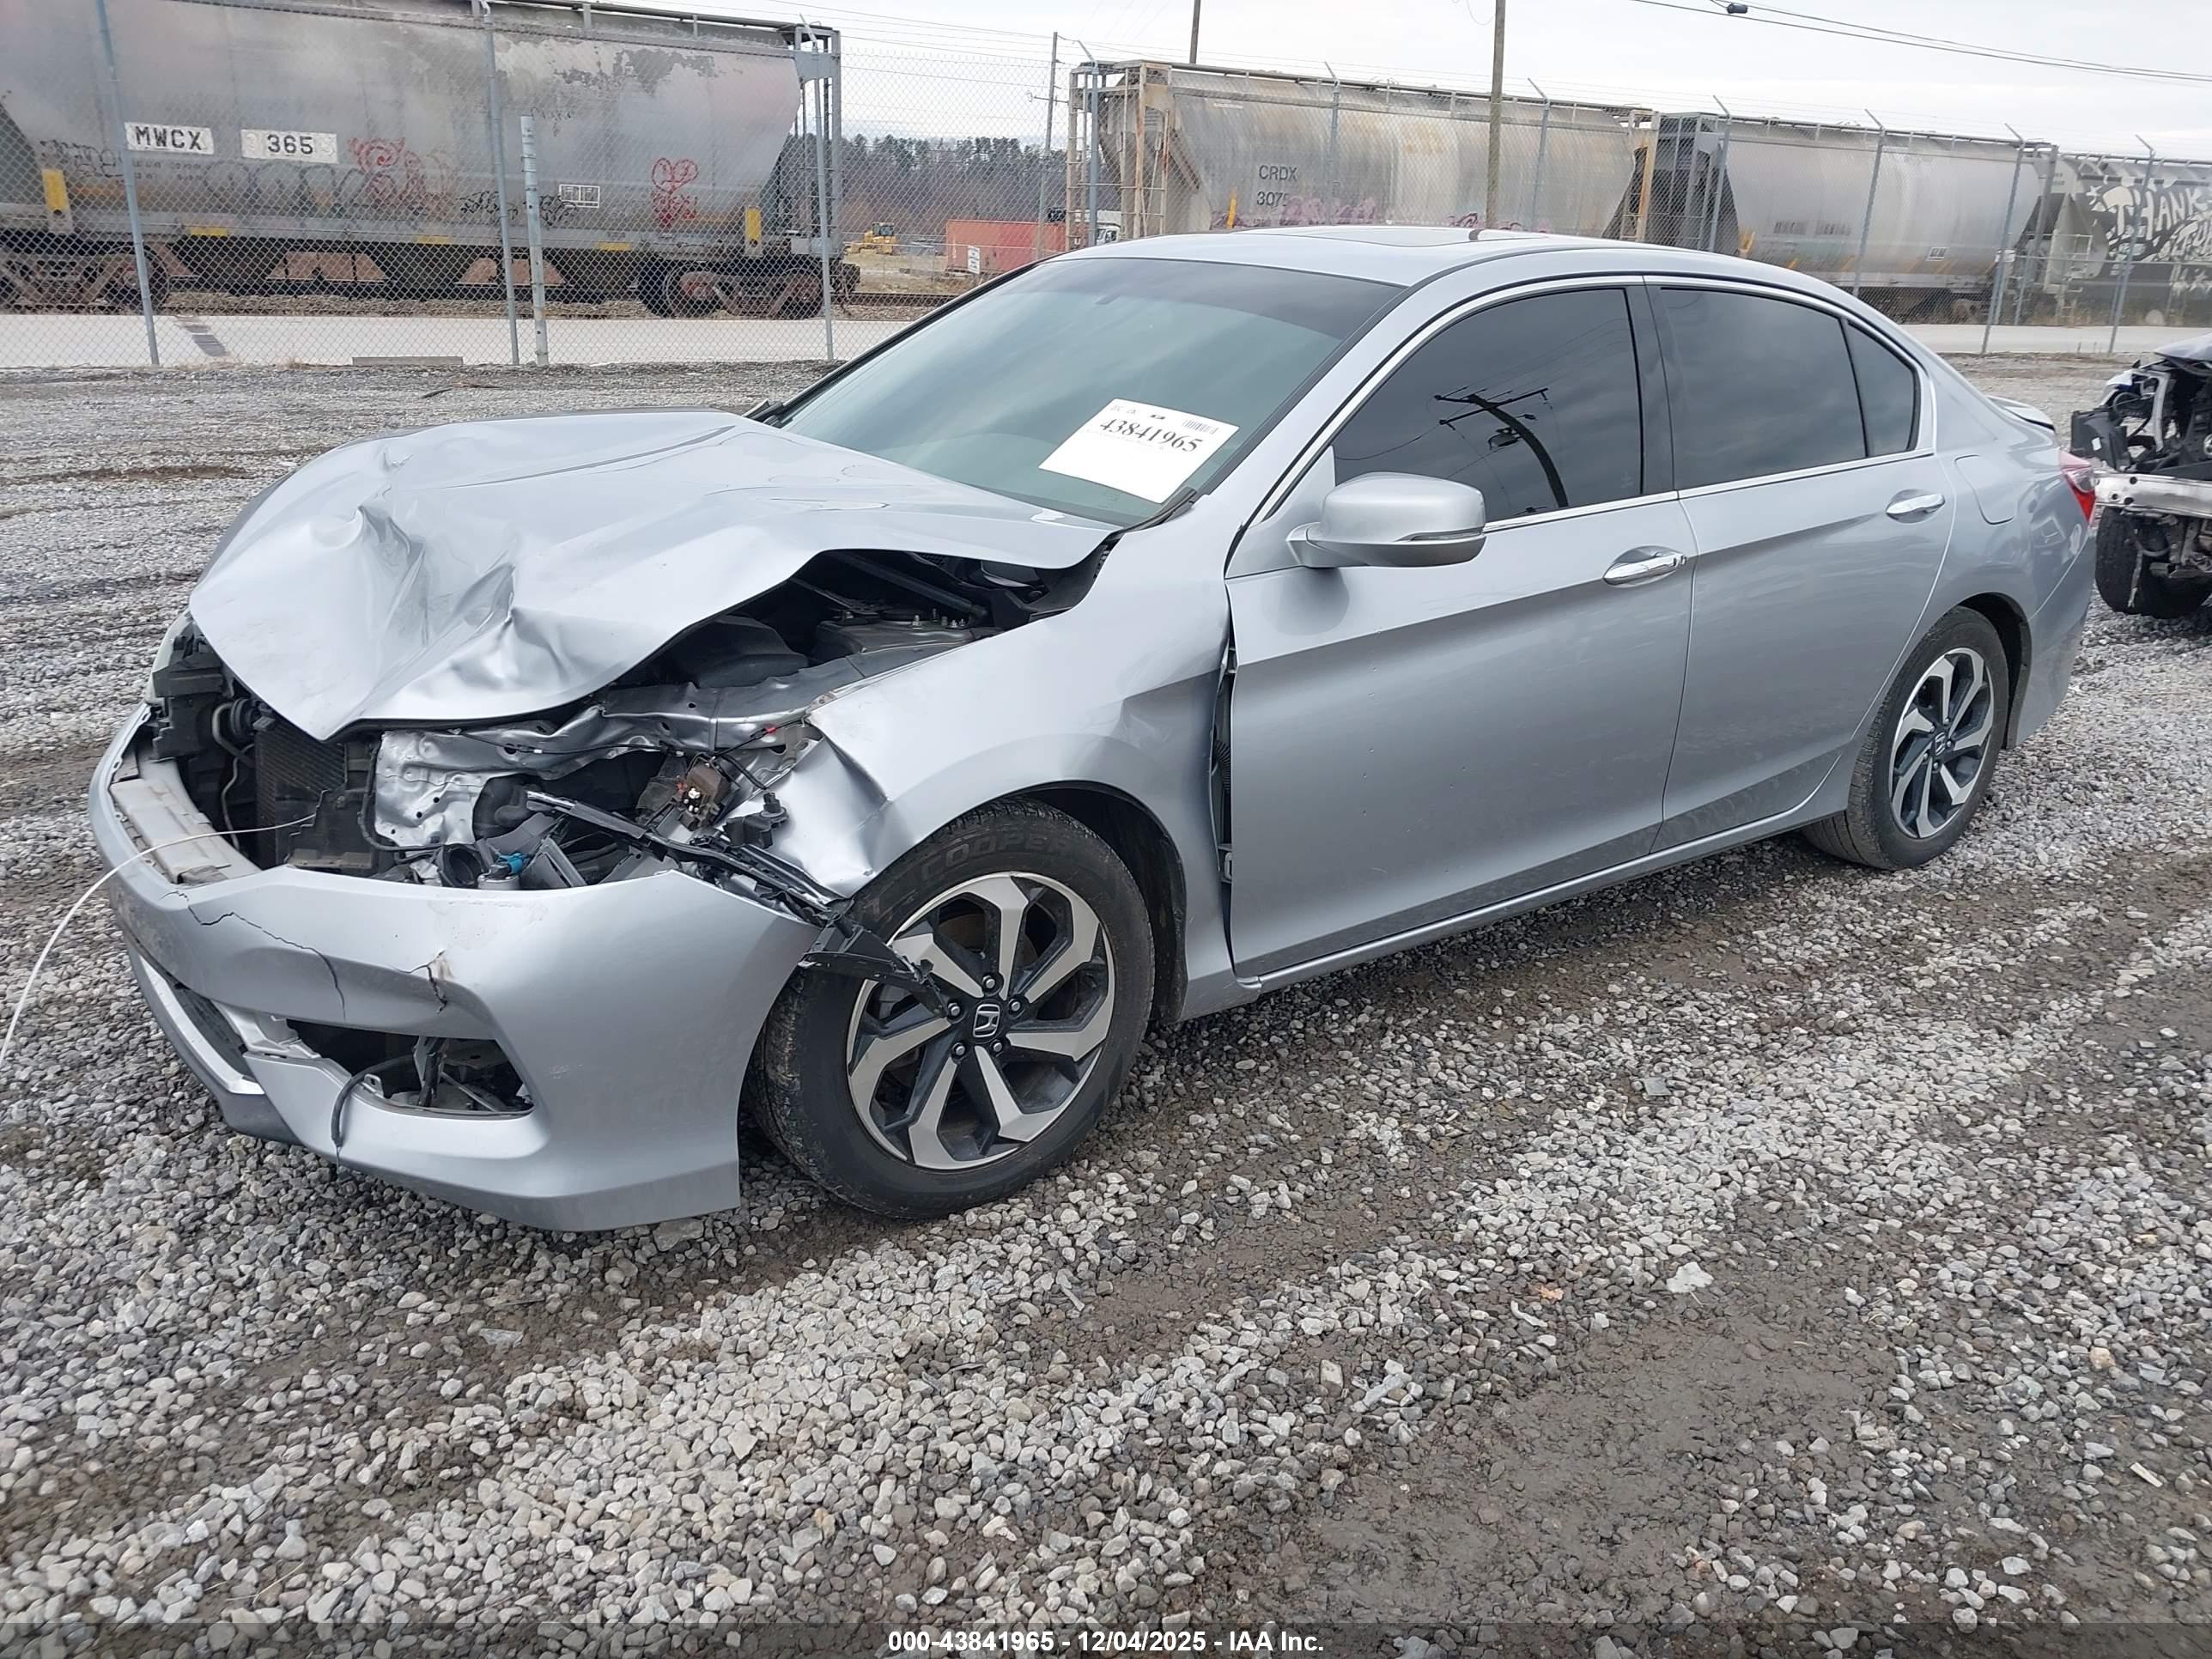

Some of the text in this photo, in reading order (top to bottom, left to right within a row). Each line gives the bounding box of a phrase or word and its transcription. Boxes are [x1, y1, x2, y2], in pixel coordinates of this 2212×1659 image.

[135, 125, 314, 155] MWCX 365
[1258, 164, 1297, 182] CRDX
[1100, 418, 1203, 452] 43841965
[921, 832, 1070, 880] COOPER
